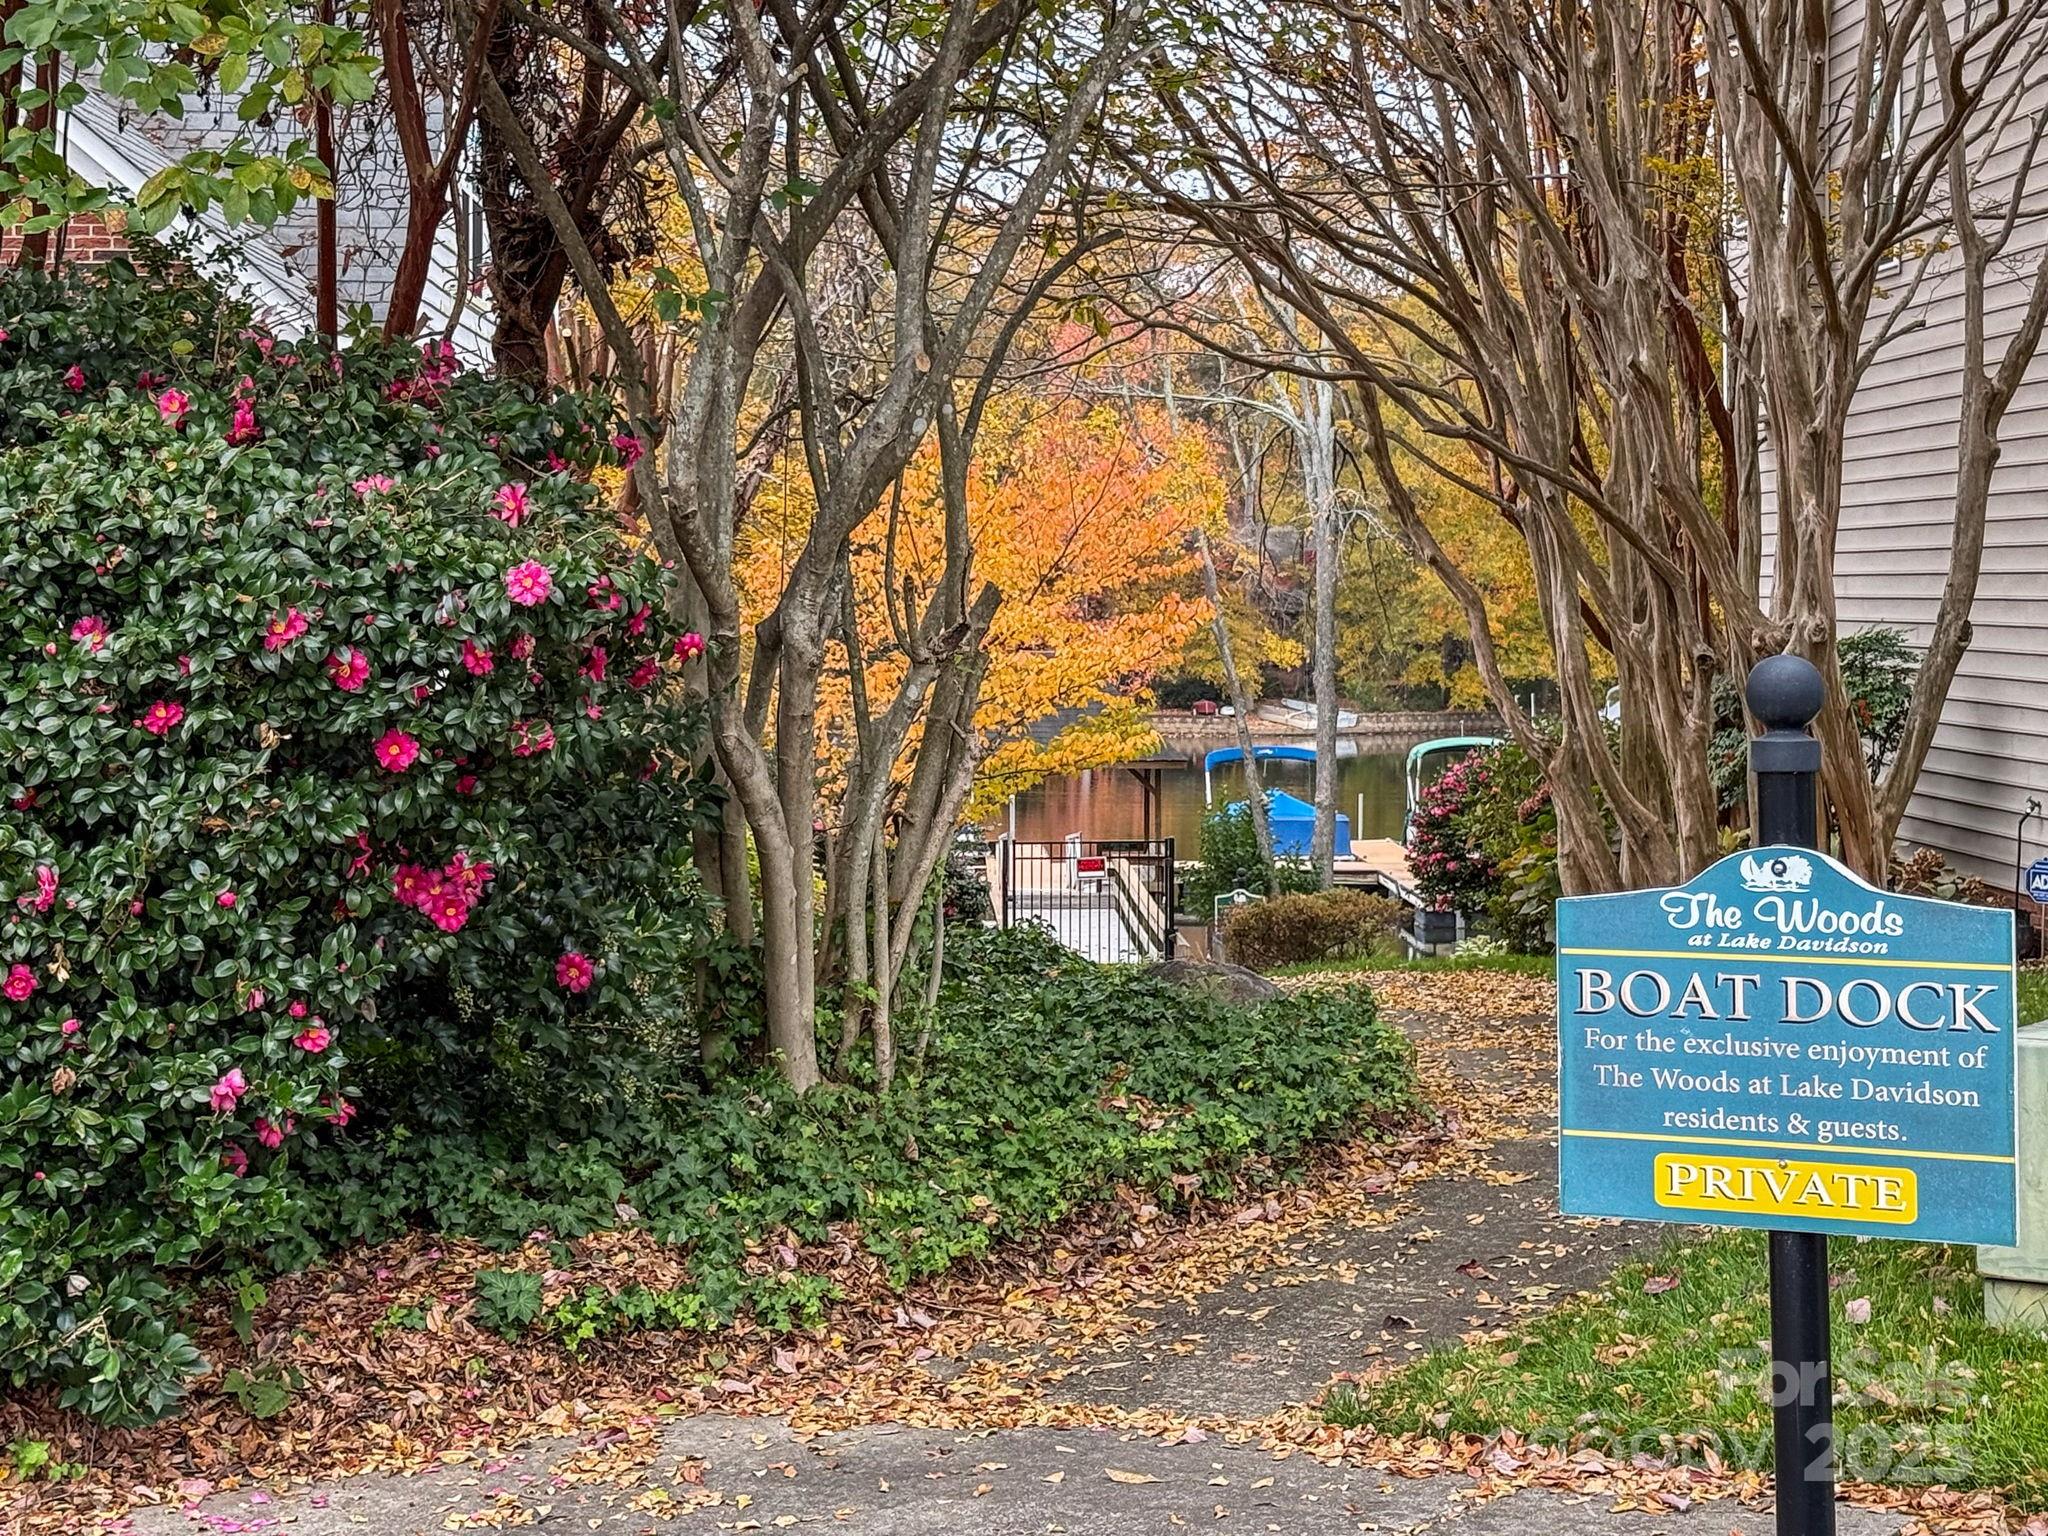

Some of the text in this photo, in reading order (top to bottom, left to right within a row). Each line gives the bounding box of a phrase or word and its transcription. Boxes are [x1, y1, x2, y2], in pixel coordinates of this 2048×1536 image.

[1660, 891, 1904, 936] The Woods
[1687, 933, 1889, 954] at Lake Davidson
[1573, 968, 2001, 1033] BOAT DOCK
[1584, 1028, 1989, 1069] For the exclusive enjoyment of
[1593, 1064, 1980, 1107] The Woods at Lake Davidson
[1663, 1107, 1908, 1143] residents & guests.
[1664, 1162, 1907, 1212] PRIVATE
